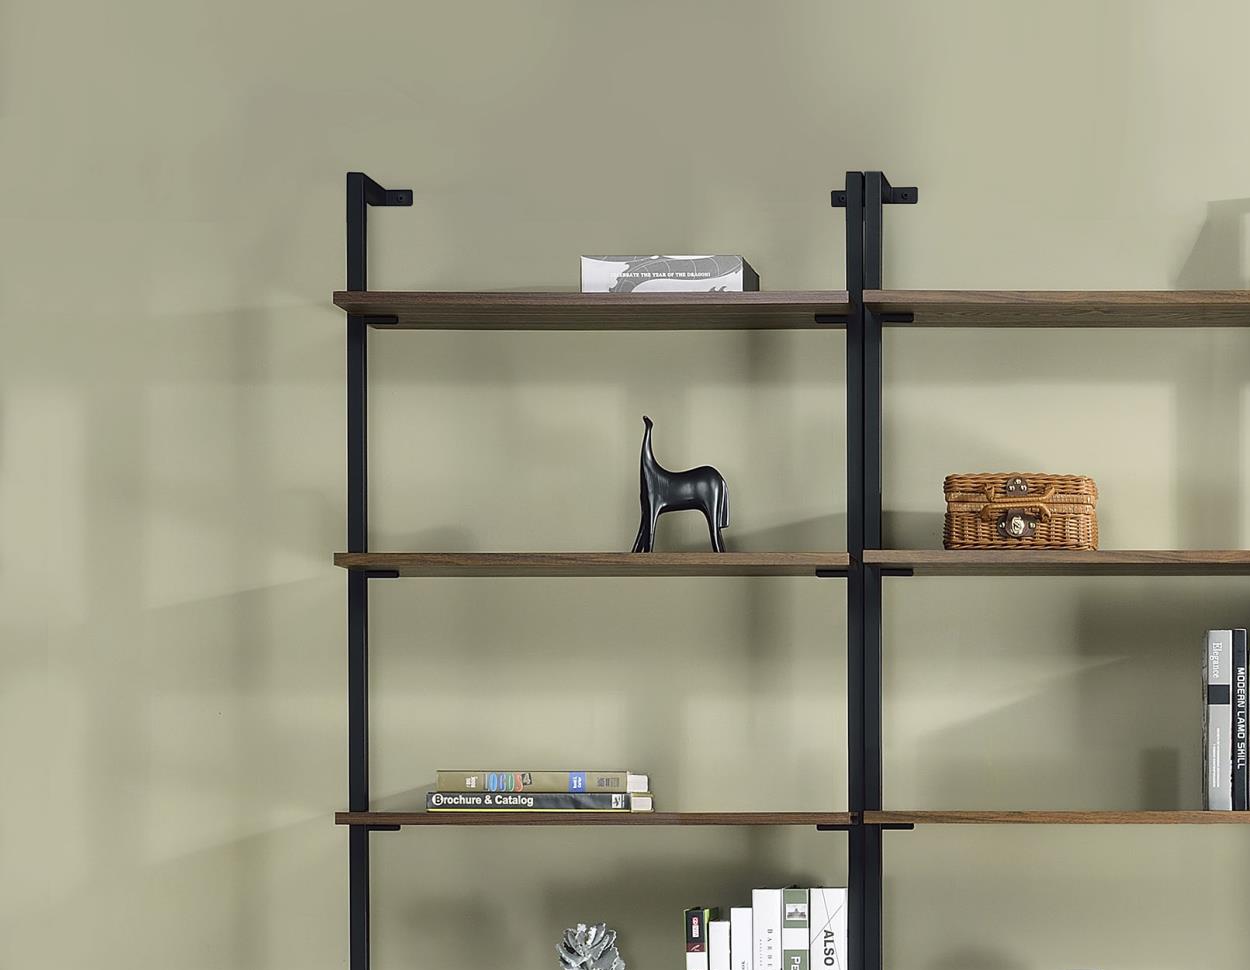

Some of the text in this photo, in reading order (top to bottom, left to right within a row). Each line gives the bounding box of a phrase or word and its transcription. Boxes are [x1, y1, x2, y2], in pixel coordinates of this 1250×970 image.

[1210, 641, 1223, 679] Elegance
[432, 793, 534, 807] Brochure & Catalog
[823, 929, 835, 967] ALSO
